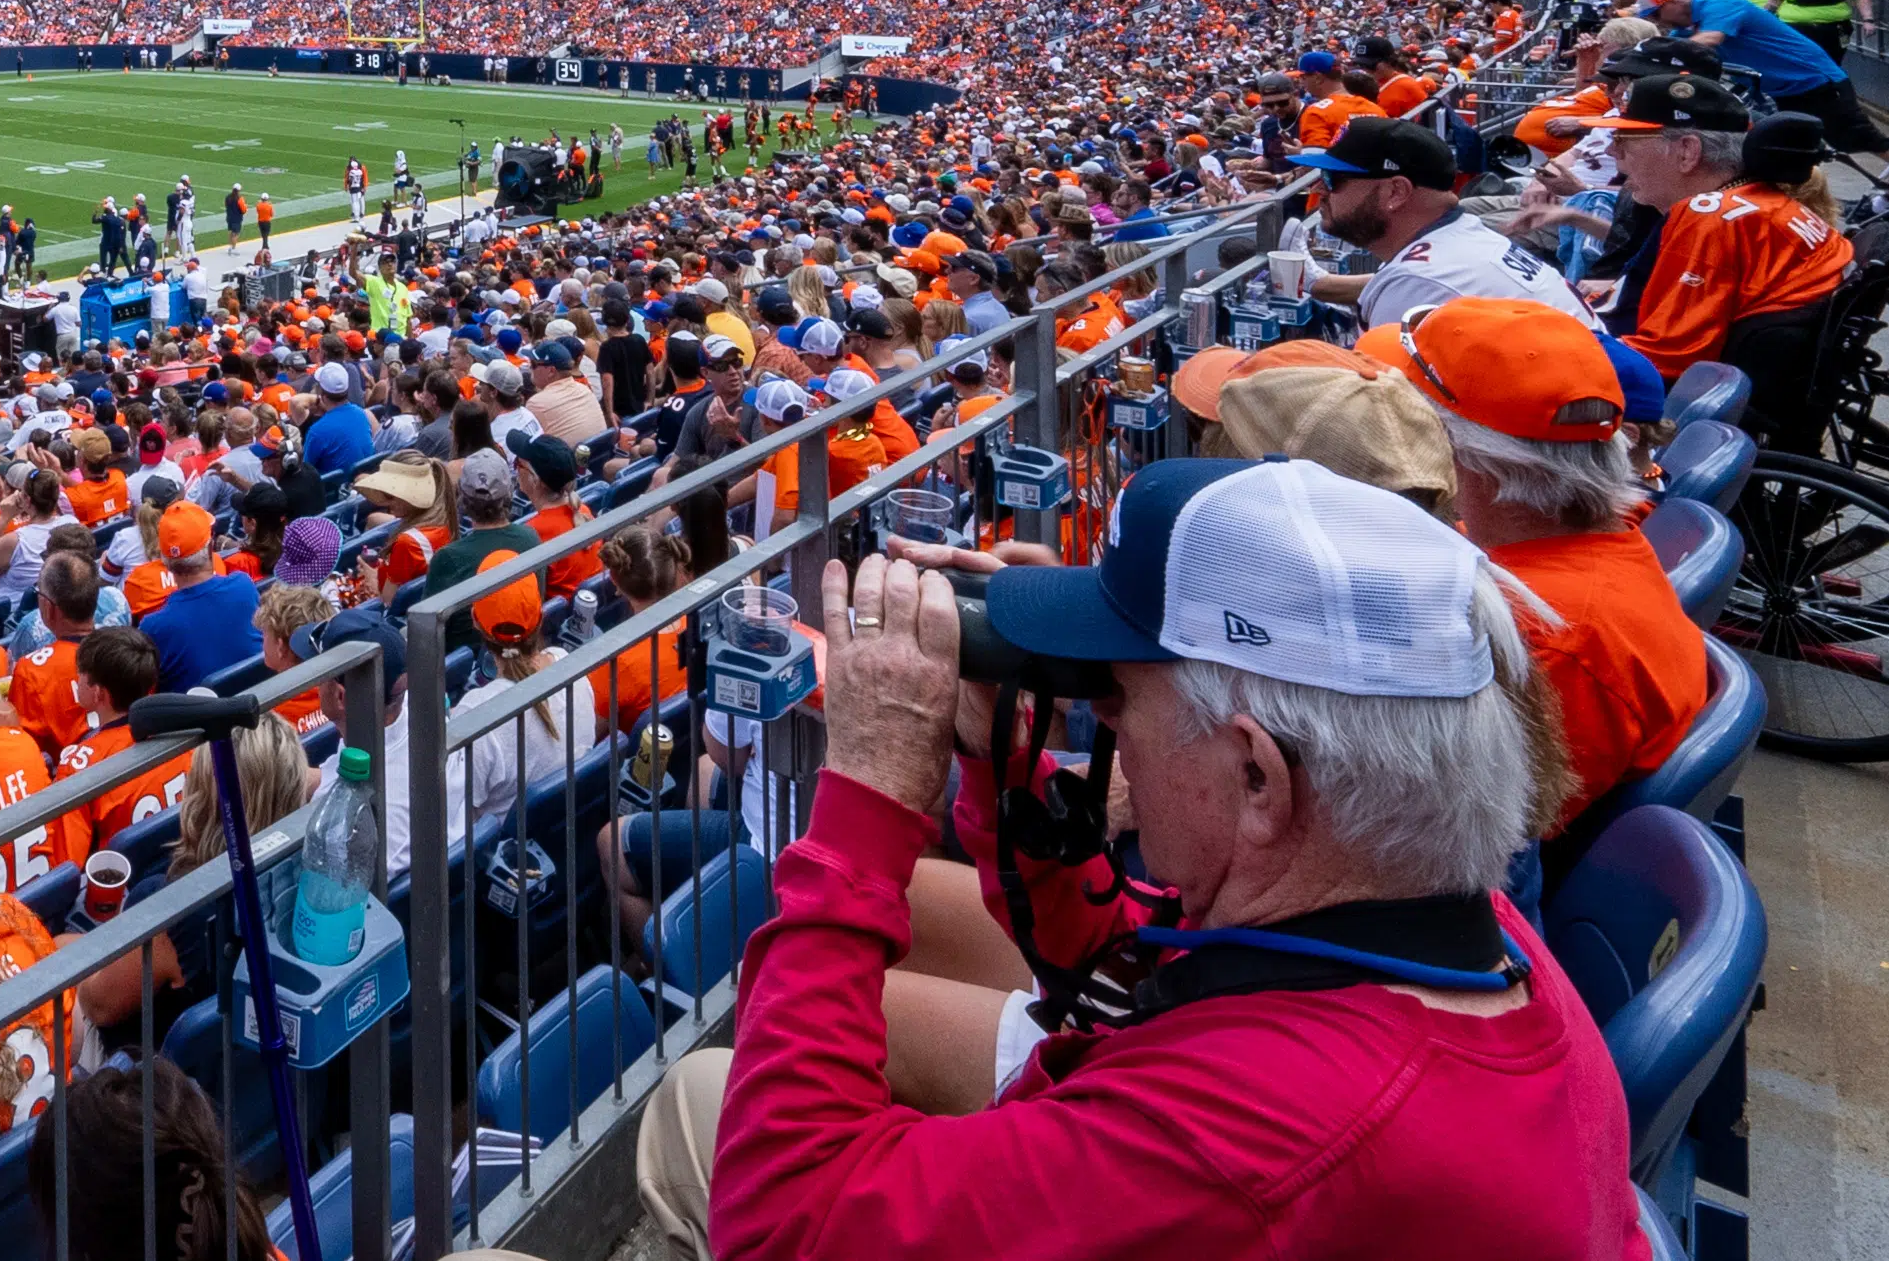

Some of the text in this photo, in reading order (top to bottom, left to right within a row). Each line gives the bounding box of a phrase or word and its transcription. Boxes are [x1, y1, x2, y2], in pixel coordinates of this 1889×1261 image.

[866, 41, 899, 52] Chevron
[355, 53, 380, 68] 3:18
[560, 62, 578, 78] 34
[1400, 241, 1432, 263] 2
